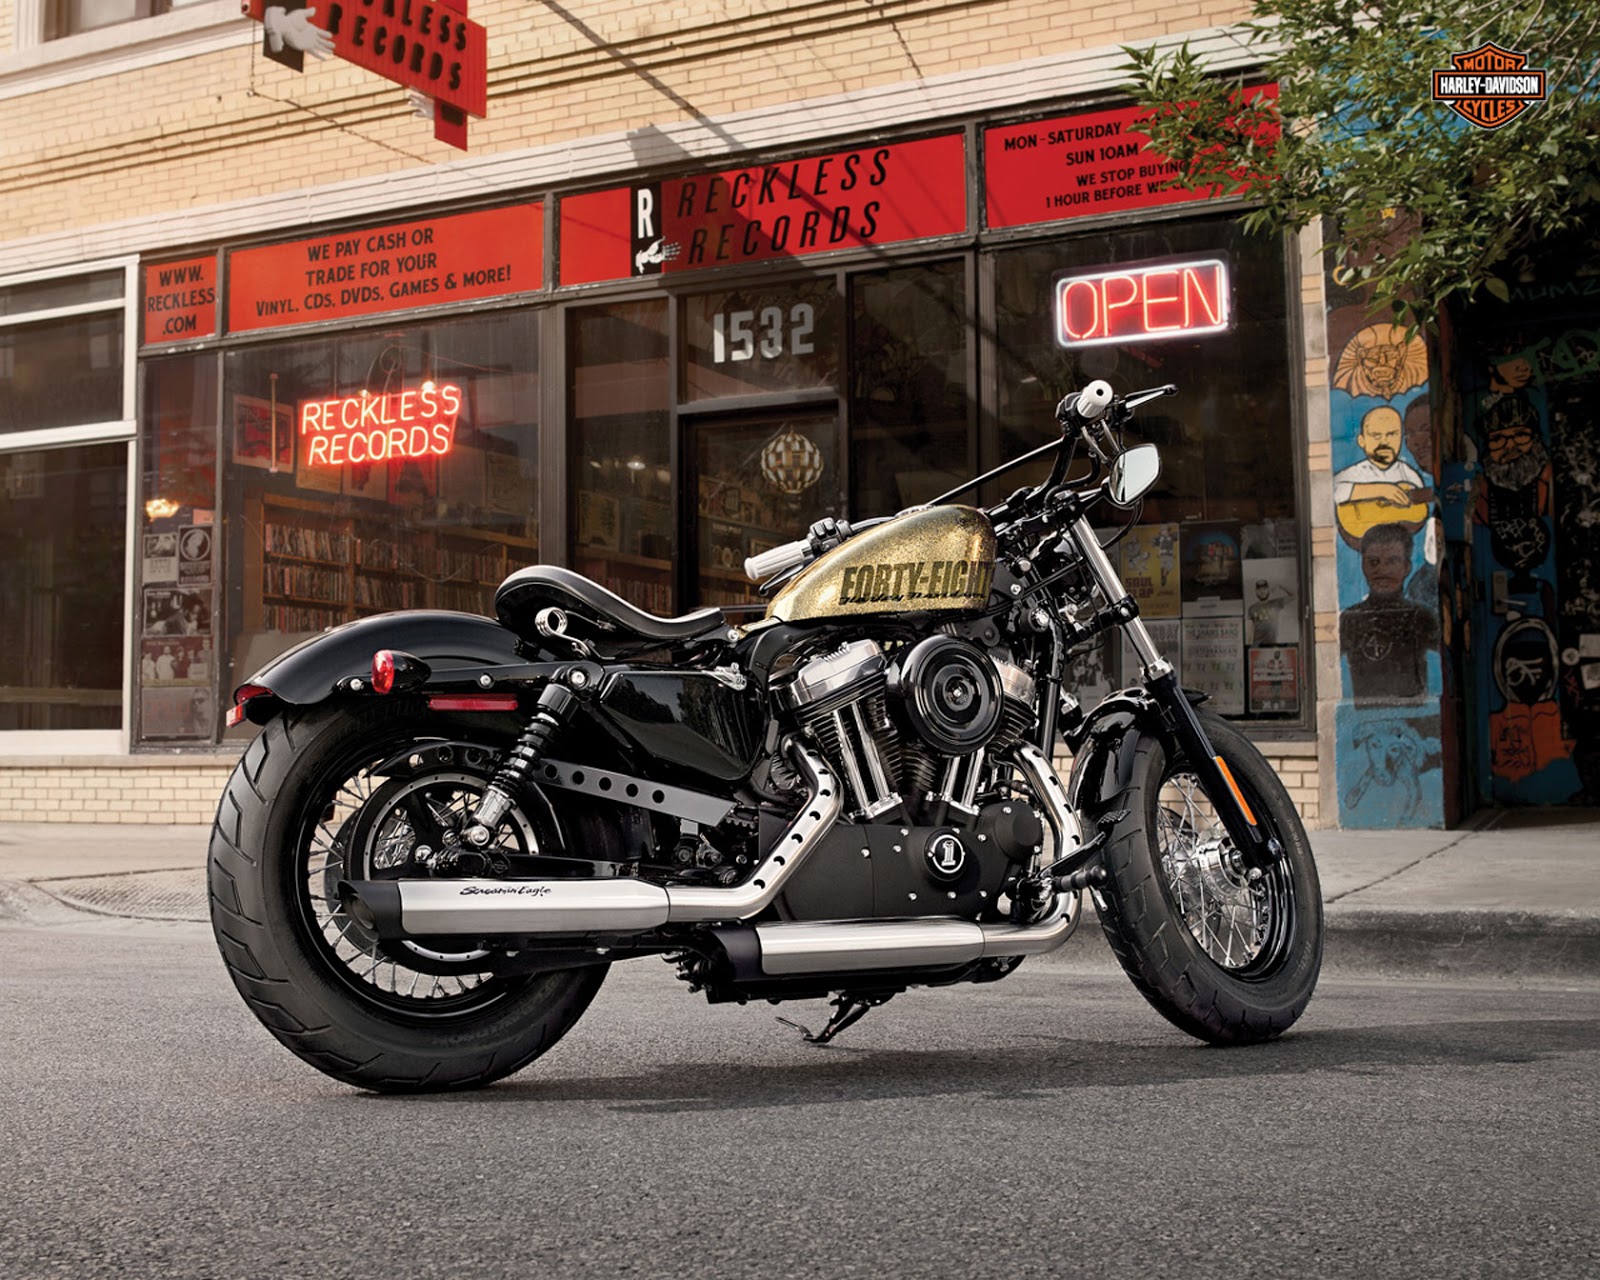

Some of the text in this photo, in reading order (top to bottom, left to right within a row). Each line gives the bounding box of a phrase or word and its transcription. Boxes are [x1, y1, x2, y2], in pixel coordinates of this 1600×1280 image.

[326, 3, 462, 91] RECORDS
[1066, 143, 1139, 166] SUN 10AM
[677, 149, 889, 218] RECKLESS
[1076, 174, 1096, 187] WE
[1101, 168, 1135, 183] STOP
[1054, 192, 1090, 207] HOUR
[1094, 184, 1142, 202] BEFORE
[637, 189, 654, 239] R
[308, 227, 434, 262] WE PAY CASH OR
[687, 201, 880, 265] RECORDS
[159, 265, 204, 287] WWW.
[306, 252, 438, 287] TRADE FOR YOUR
[390, 277, 440, 299] GAMES
[444, 273, 457, 290] &
[463, 264, 512, 288] MORE!
[147, 287, 216, 312] RECKLESS
[1063, 265, 1222, 340] OPEN
[162, 314, 198, 335] .COM
[713, 303, 814, 363] 1532
[302, 386, 460, 434] RECKLESS
[308, 424, 450, 466] RECORDS
[840, 560, 995, 600] FORTY-EIGHT
[518, 886, 552, 897] Eagle
